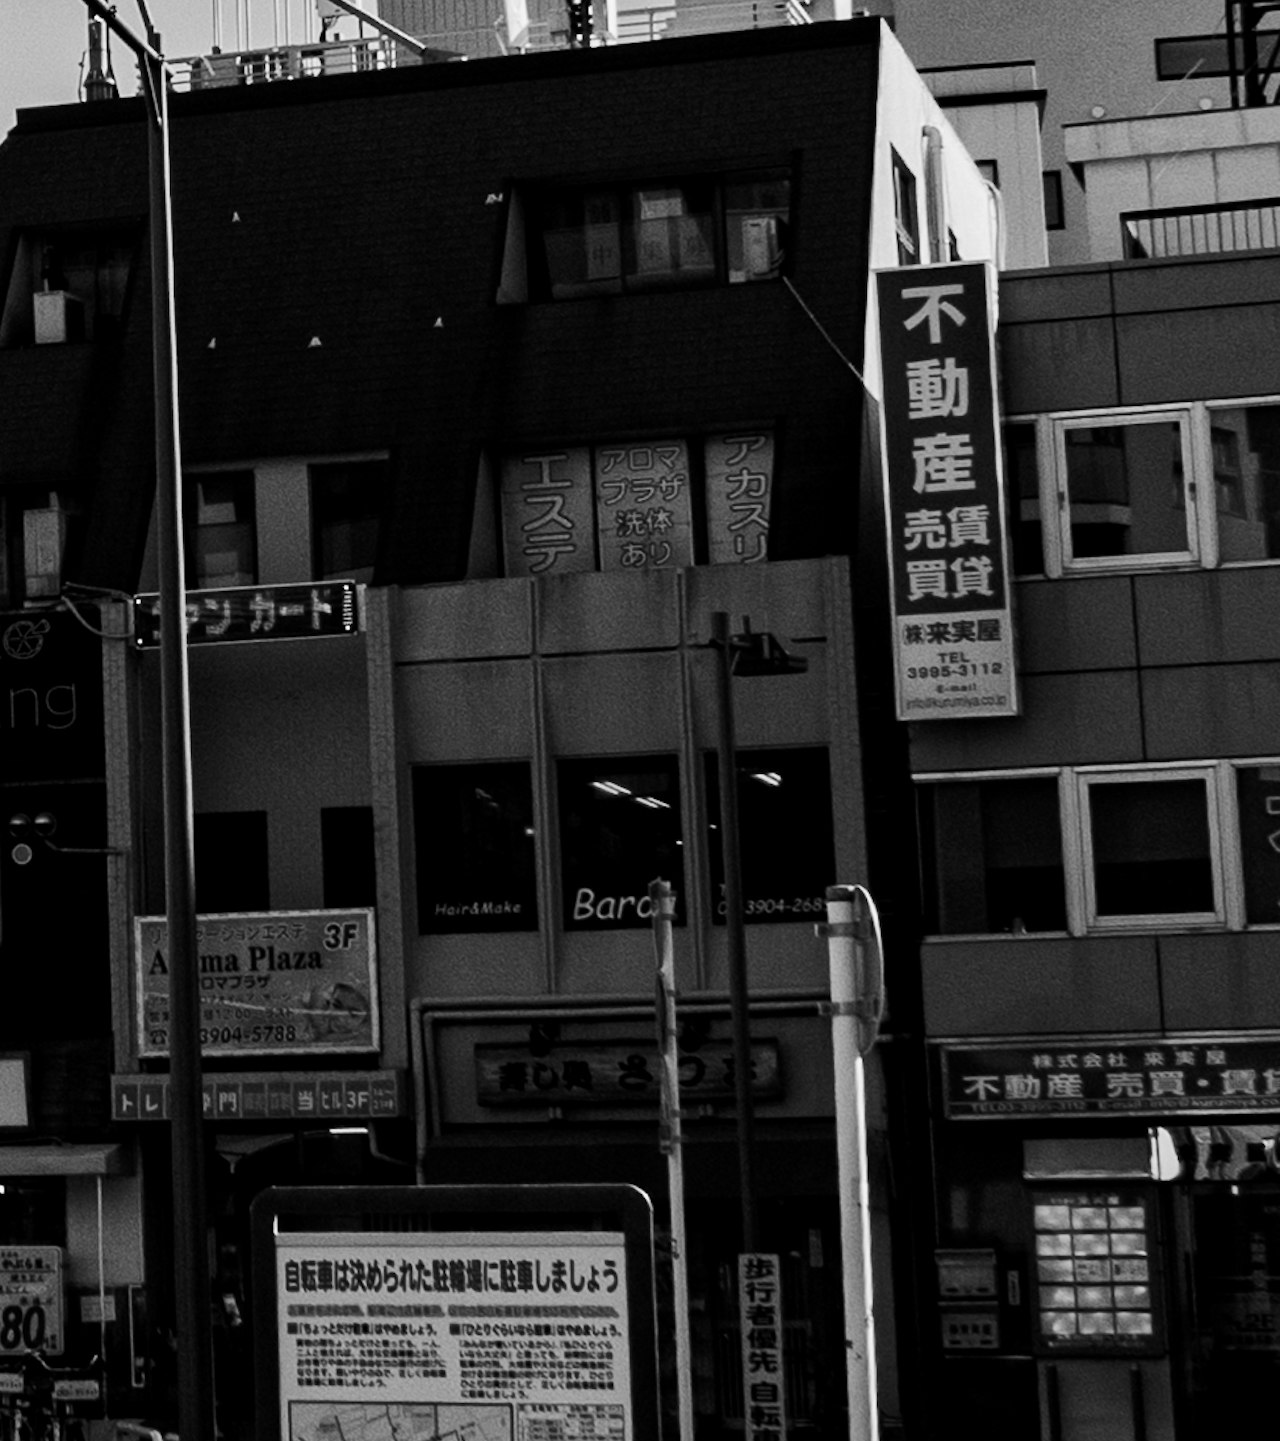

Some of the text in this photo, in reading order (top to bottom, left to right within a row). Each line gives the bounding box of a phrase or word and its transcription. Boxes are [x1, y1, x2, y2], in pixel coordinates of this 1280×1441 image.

[901, 283, 976, 494] 不動産
[602, 446, 680, 472] アロマ
[602, 474, 685, 505] プラザ
[724, 435, 770, 564] アカスリ
[521, 453, 575, 573] エステ
[616, 508, 673, 537] 洗体
[621, 542, 672, 568] あり
[937, 652, 970, 663] TEL
[325, 923, 358, 949] 3F
[149, 946, 322, 976] Ama Plaza
[201, 974, 271, 989] ロマプラザ
[1032, 1052, 1128, 1069] 株式会社
[962, 1073, 1084, 1100] 不動産
[0, 1305, 46, 1350] 80
[745, 1258, 778, 1373] 歩行者優先
